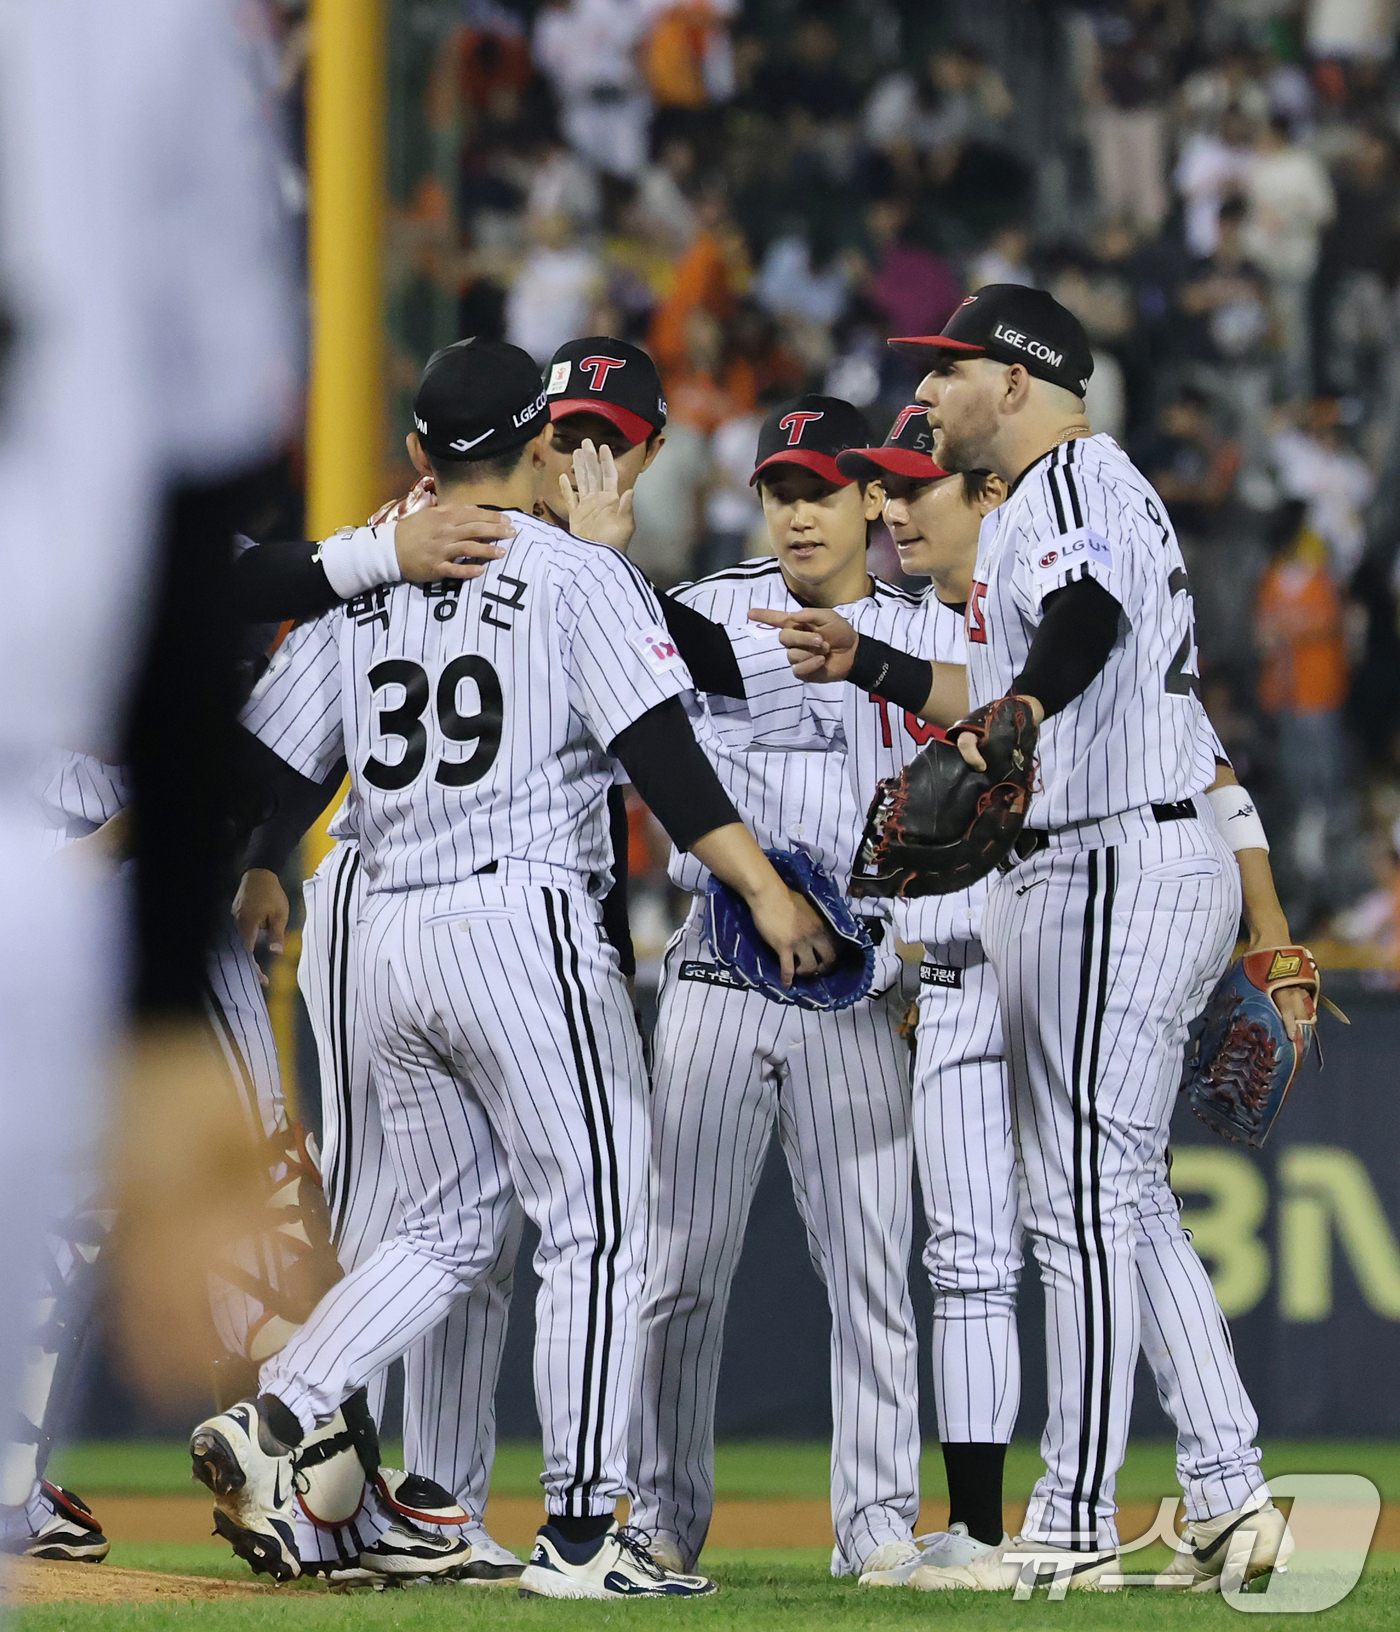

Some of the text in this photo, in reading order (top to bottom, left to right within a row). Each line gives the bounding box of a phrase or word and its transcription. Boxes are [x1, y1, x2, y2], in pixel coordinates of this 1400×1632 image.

[994, 325, 1063, 368] LGE.COM
[579, 355, 627, 391] T
[512, 391, 547, 429] LGE.CO
[779, 411, 825, 446] T
[1062, 540, 1085, 556] LG
[1089, 538, 1110, 552] U+
[361, 652, 504, 793] 39
